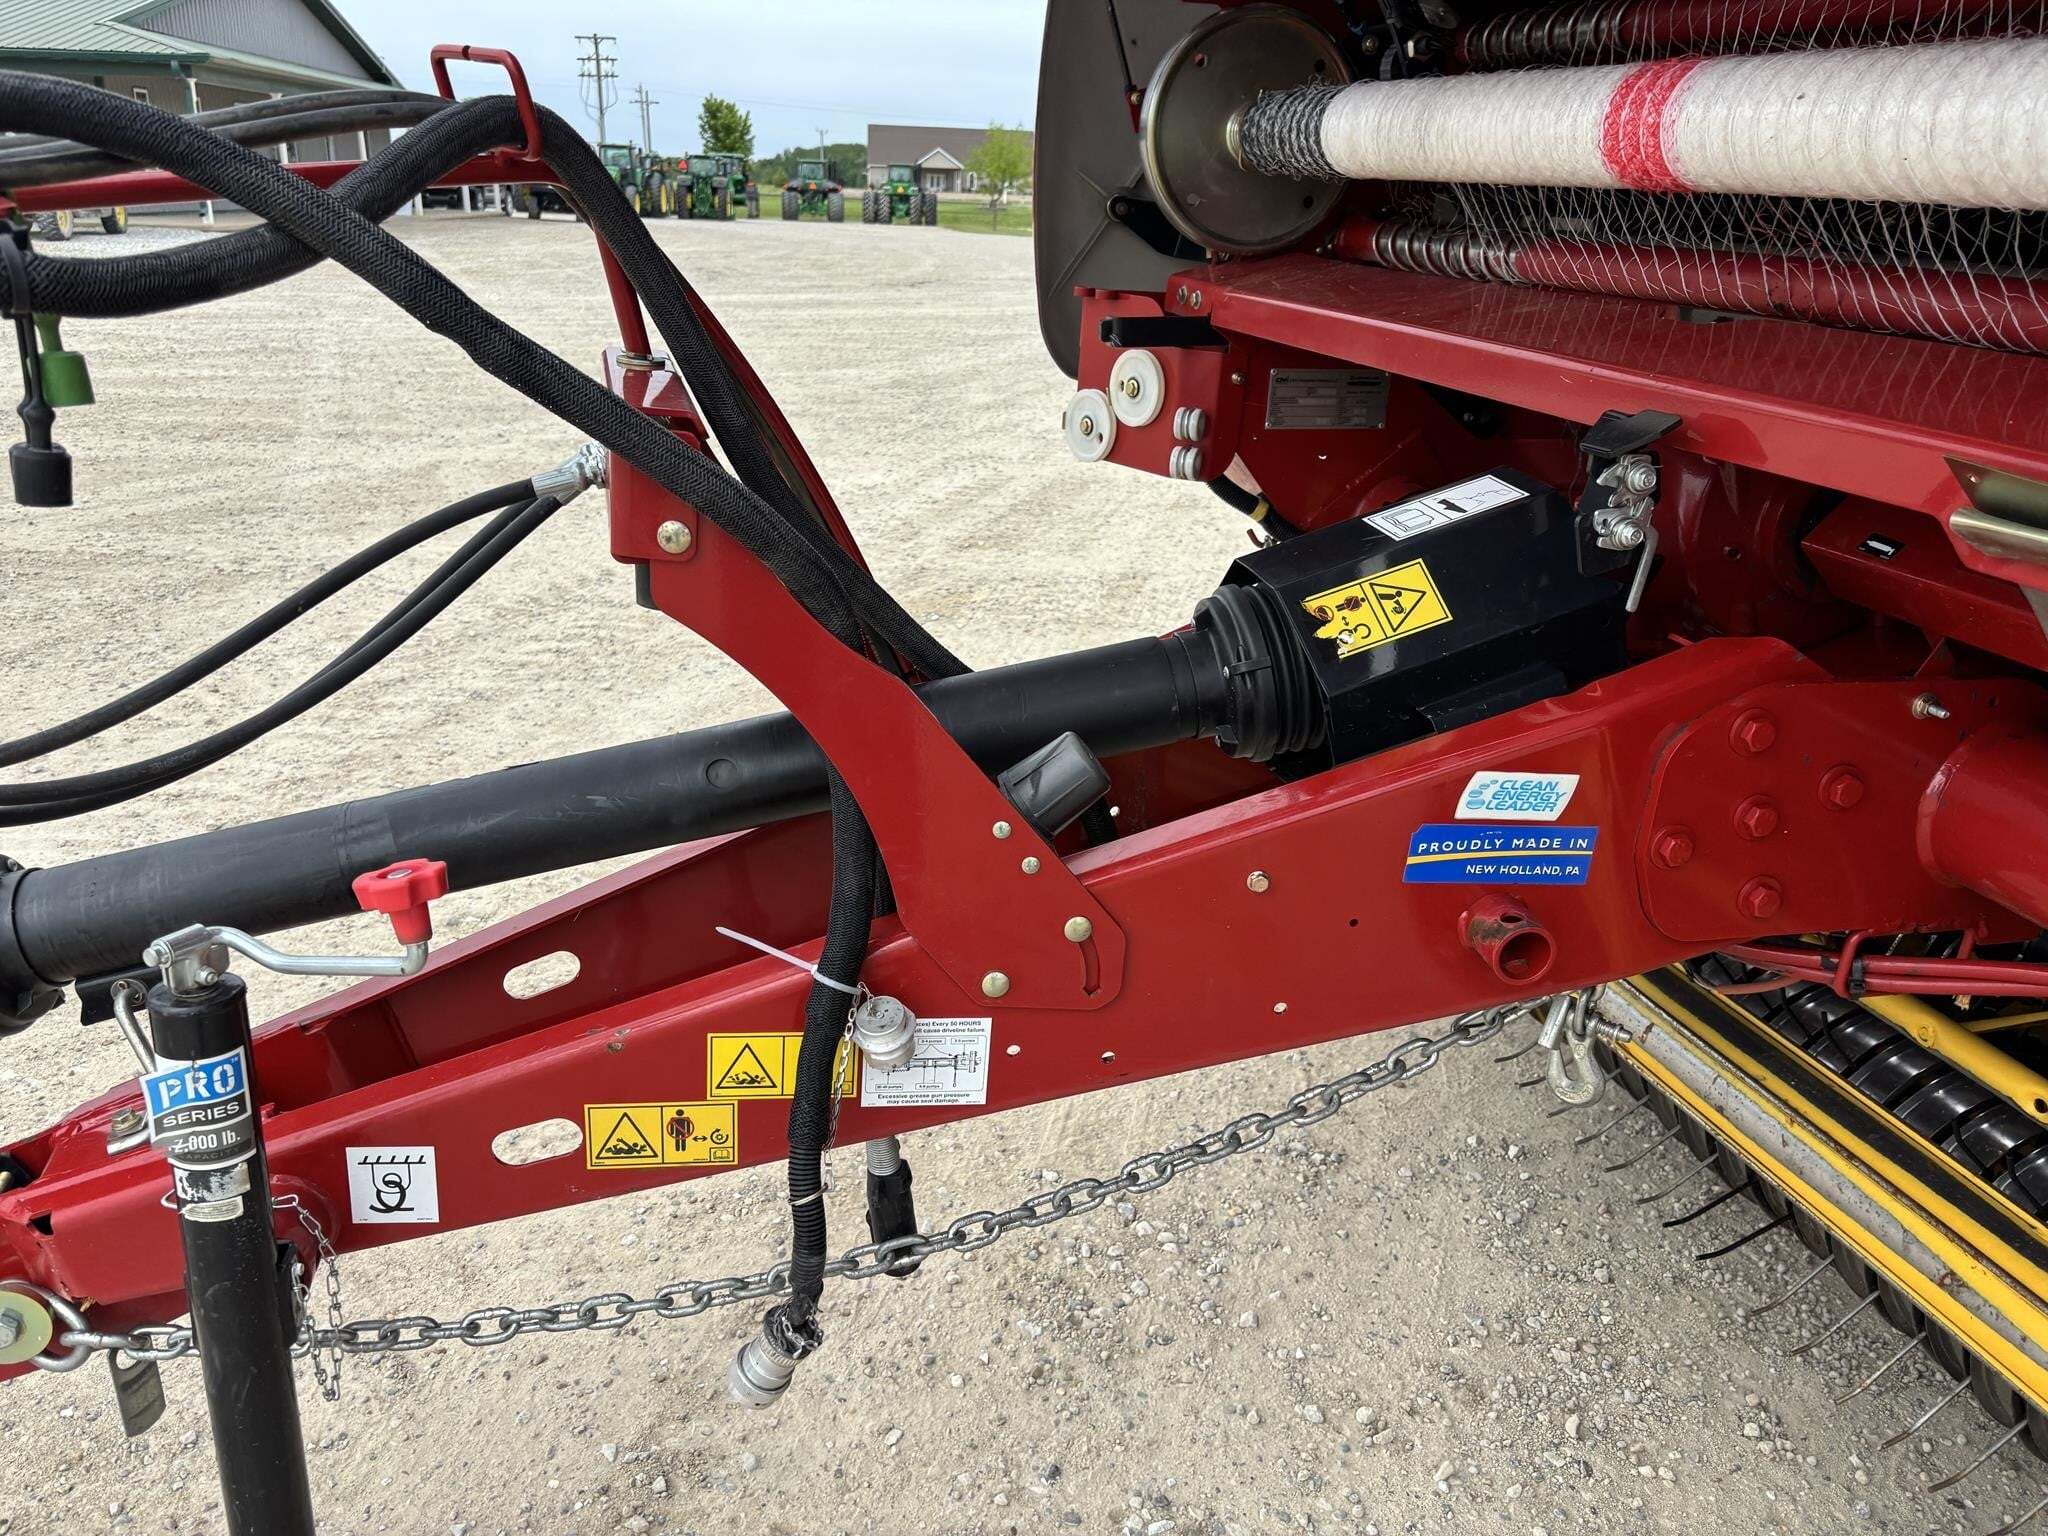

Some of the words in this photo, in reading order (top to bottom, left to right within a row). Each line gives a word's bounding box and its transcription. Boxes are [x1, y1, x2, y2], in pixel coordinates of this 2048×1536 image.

[1499, 779, 1560, 792] CLEAN
[1491, 790, 1567, 802] ENERGY
[1485, 800, 1558, 812] LEADER
[1417, 838, 1505, 854] PROUDLY
[1511, 838, 1563, 849] MADE
[1568, 838, 1589, 849] IN
[1465, 864, 1496, 875] NEW
[1499, 864, 1562, 877] HOLLAND,
[1565, 866, 1580, 876] PA
[158, 1063, 237, 1110] PRO
[163, 1101, 240, 1128] SERIES
[221, 1129, 241, 1146] lb.
